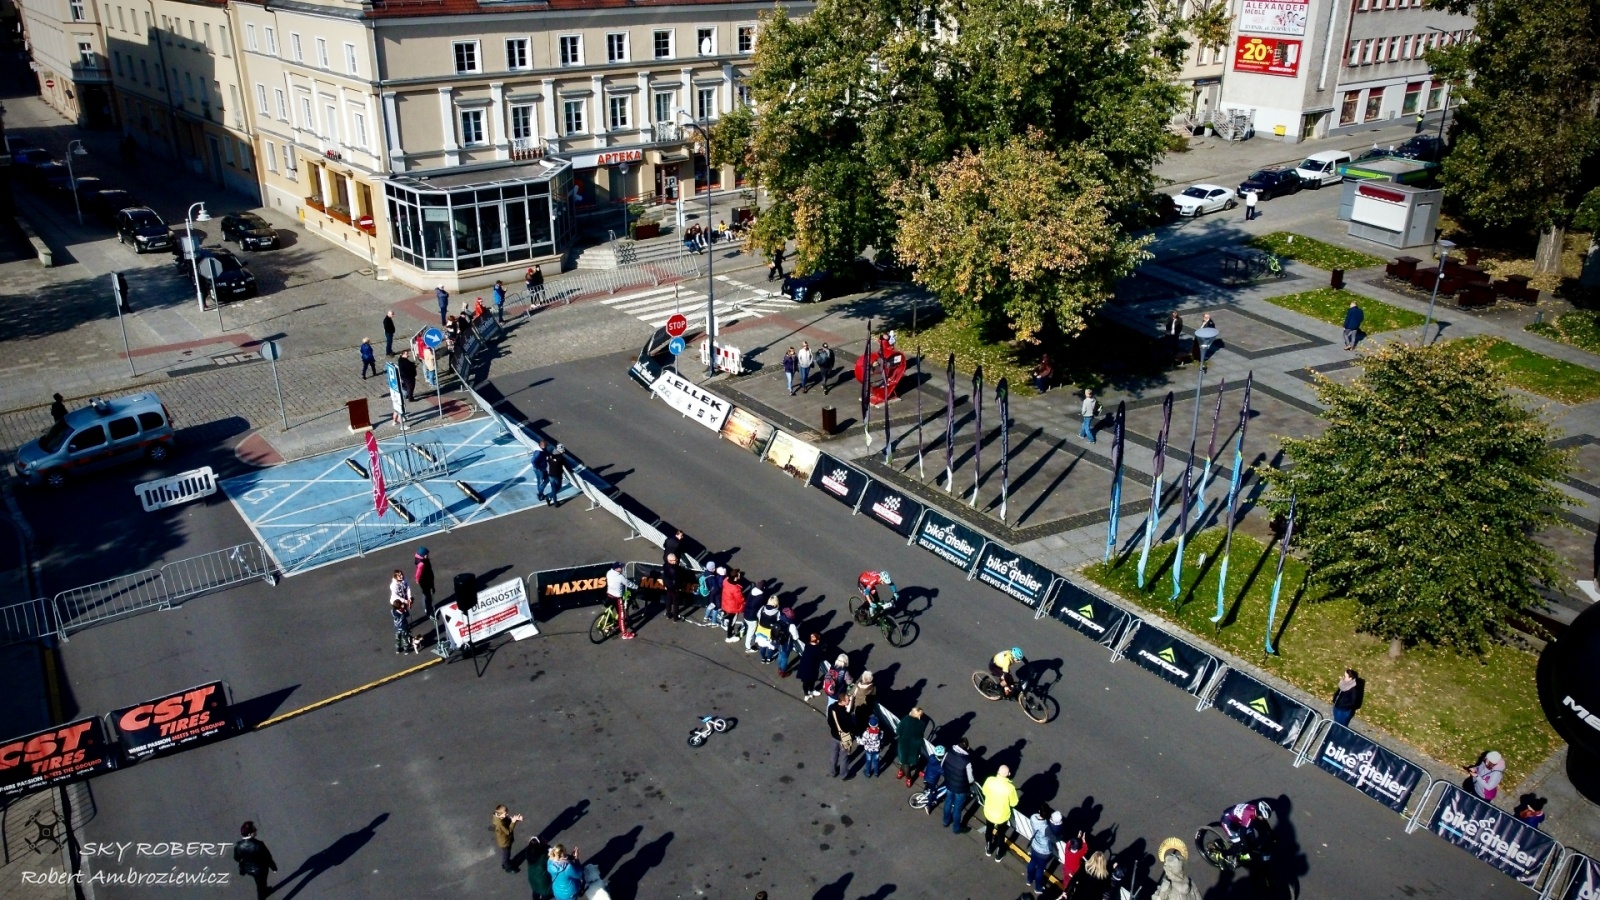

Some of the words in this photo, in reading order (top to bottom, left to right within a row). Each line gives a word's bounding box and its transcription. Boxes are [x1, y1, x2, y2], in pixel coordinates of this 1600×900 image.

[1245, 2, 1305, 11] ALEXANDER
[597, 151, 641, 165] APTEKA
[668, 320, 686, 331] STOP
[666, 376, 723, 412] LELLEK
[918, 538, 935, 551] SKLEP
[934, 545, 968, 569] ROWEROWY
[924, 521, 944, 540] bike
[945, 533, 976, 556] atelier
[545, 577, 607, 596] MAXXIS
[985, 554, 1008, 575] bike
[1009, 568, 1043, 592] atelier
[471, 586, 522, 613] DIAGNOSTIX
[980, 573, 1002, 588] SERWIS
[1000, 583, 1036, 606] ROWEROWY
[1060, 606, 1106, 634] MERIDA
[1138, 649, 1190, 679] MERIDA
[119, 685, 216, 731] CST
[1227, 698, 1284, 732] MERIDA
[147, 737, 171, 749] PASSION
[200, 721, 226, 732] GROUND
[160, 711, 210, 737] TIRES
[0, 721, 92, 770] CST
[31, 749, 86, 775] TIRES
[75, 758, 102, 771] GROUND
[1324, 741, 1356, 769] bike
[1358, 762, 1407, 797] atelier
[1441, 805, 1478, 837] bike
[1480, 830, 1537, 867] atelier
